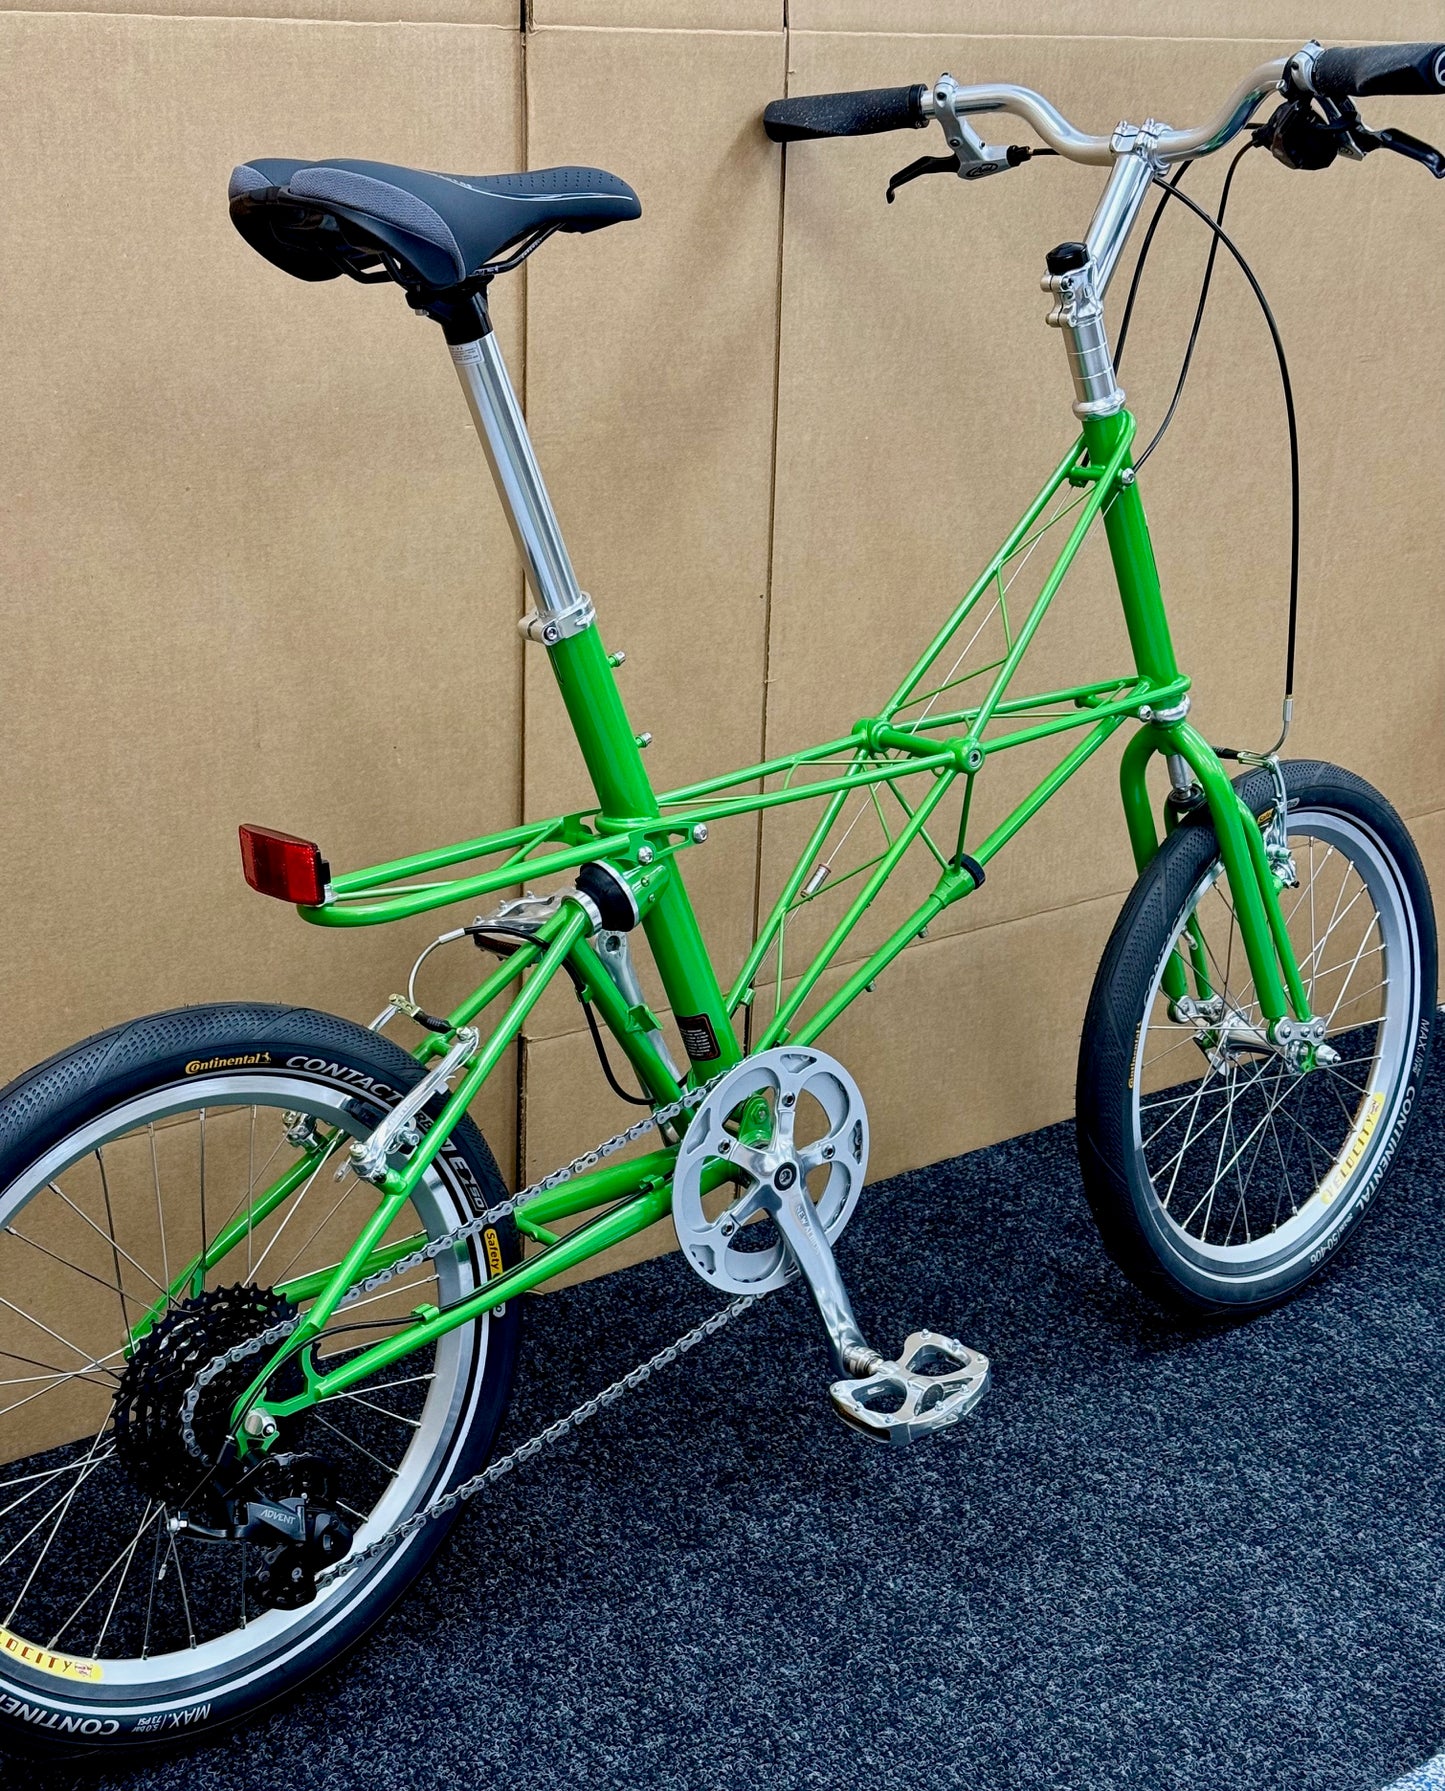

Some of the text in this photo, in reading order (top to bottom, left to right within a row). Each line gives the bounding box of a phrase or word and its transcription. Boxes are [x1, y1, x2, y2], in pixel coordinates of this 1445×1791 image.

[184, 1053, 261, 1075] Continental
[285, 1055, 405, 1102] CONTACT
[1356, 1085, 1416, 1211] CONTINENTAL
[486, 1232, 500, 1271] Safety
[260, 1508, 297, 1525] ADVENT
[0, 1631, 73, 1672] OCITY
